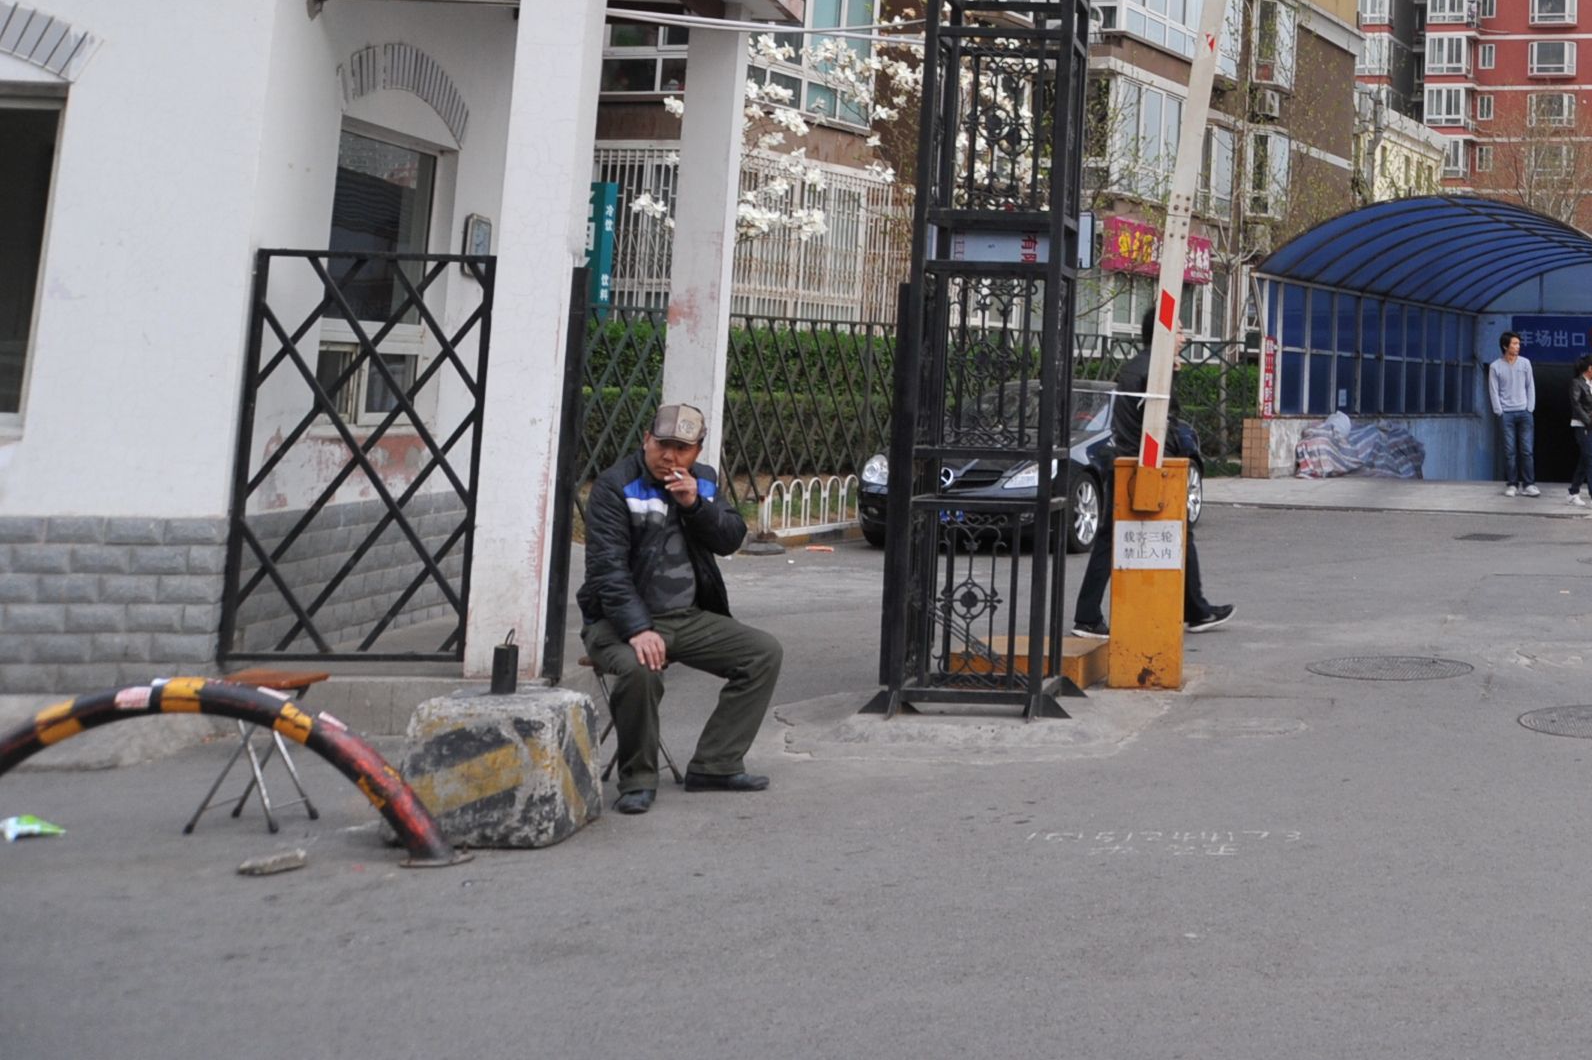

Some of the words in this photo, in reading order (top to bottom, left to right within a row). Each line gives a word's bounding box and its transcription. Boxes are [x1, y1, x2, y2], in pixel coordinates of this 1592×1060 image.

[1123, 530, 1174, 544] 载客三轮
[1123, 547, 1173, 561] 禁止入内
